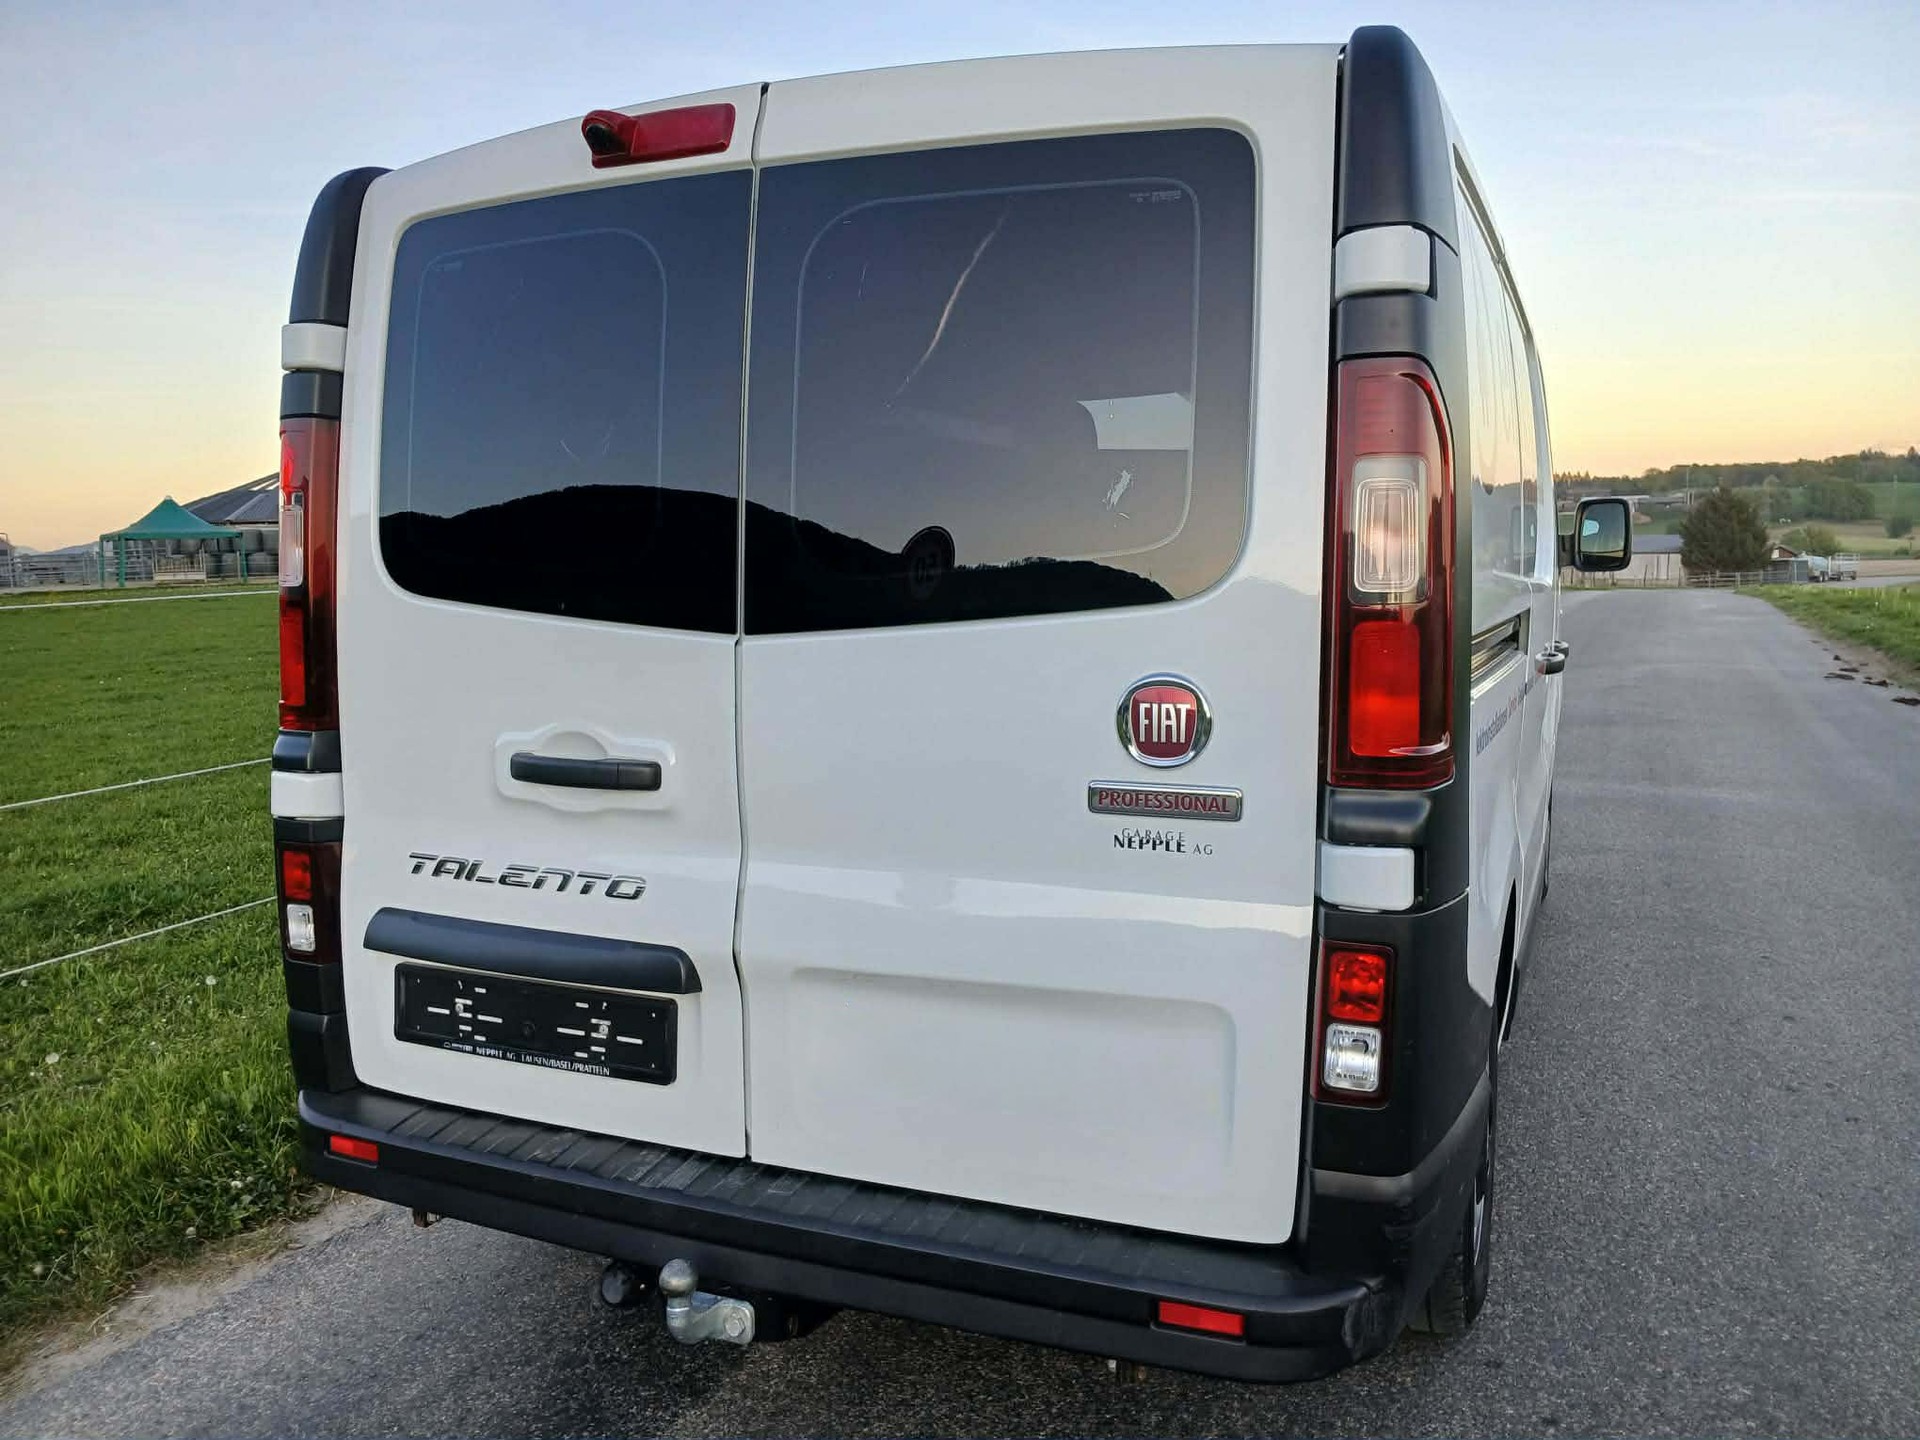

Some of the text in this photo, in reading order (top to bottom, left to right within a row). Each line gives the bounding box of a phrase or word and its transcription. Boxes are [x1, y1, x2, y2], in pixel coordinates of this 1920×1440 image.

[1139, 702, 1192, 744] FIAT
[1098, 789, 1232, 814] PROFESSIONAL
[1113, 834, 1213, 856] NEPPLE AG
[1121, 827, 1186, 842] GARAGE
[408, 851, 647, 901] TALENTO
